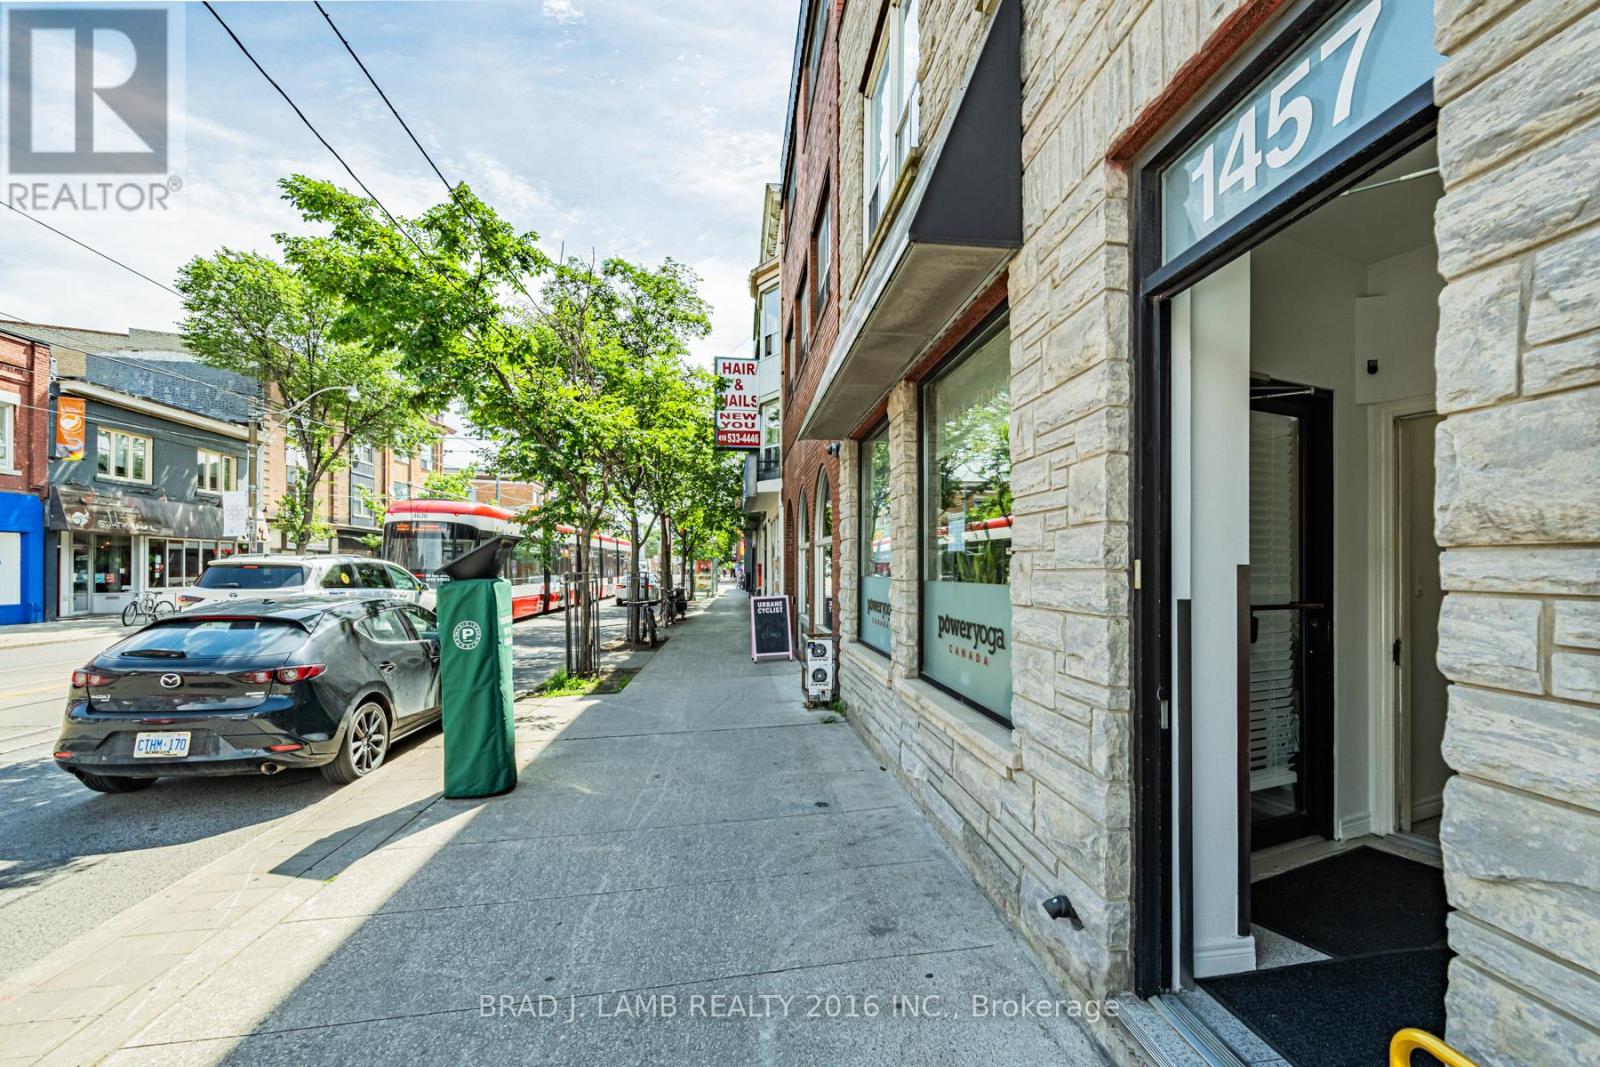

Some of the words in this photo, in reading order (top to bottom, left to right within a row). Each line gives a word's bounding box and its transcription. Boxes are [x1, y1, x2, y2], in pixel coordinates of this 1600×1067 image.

[1191, 0, 1382, 222] 1457
[722, 362, 756, 375] HAIR
[734, 378, 744, 391] &
[721, 421, 755, 429] YOU
[949, 644, 989, 666] CANADA
